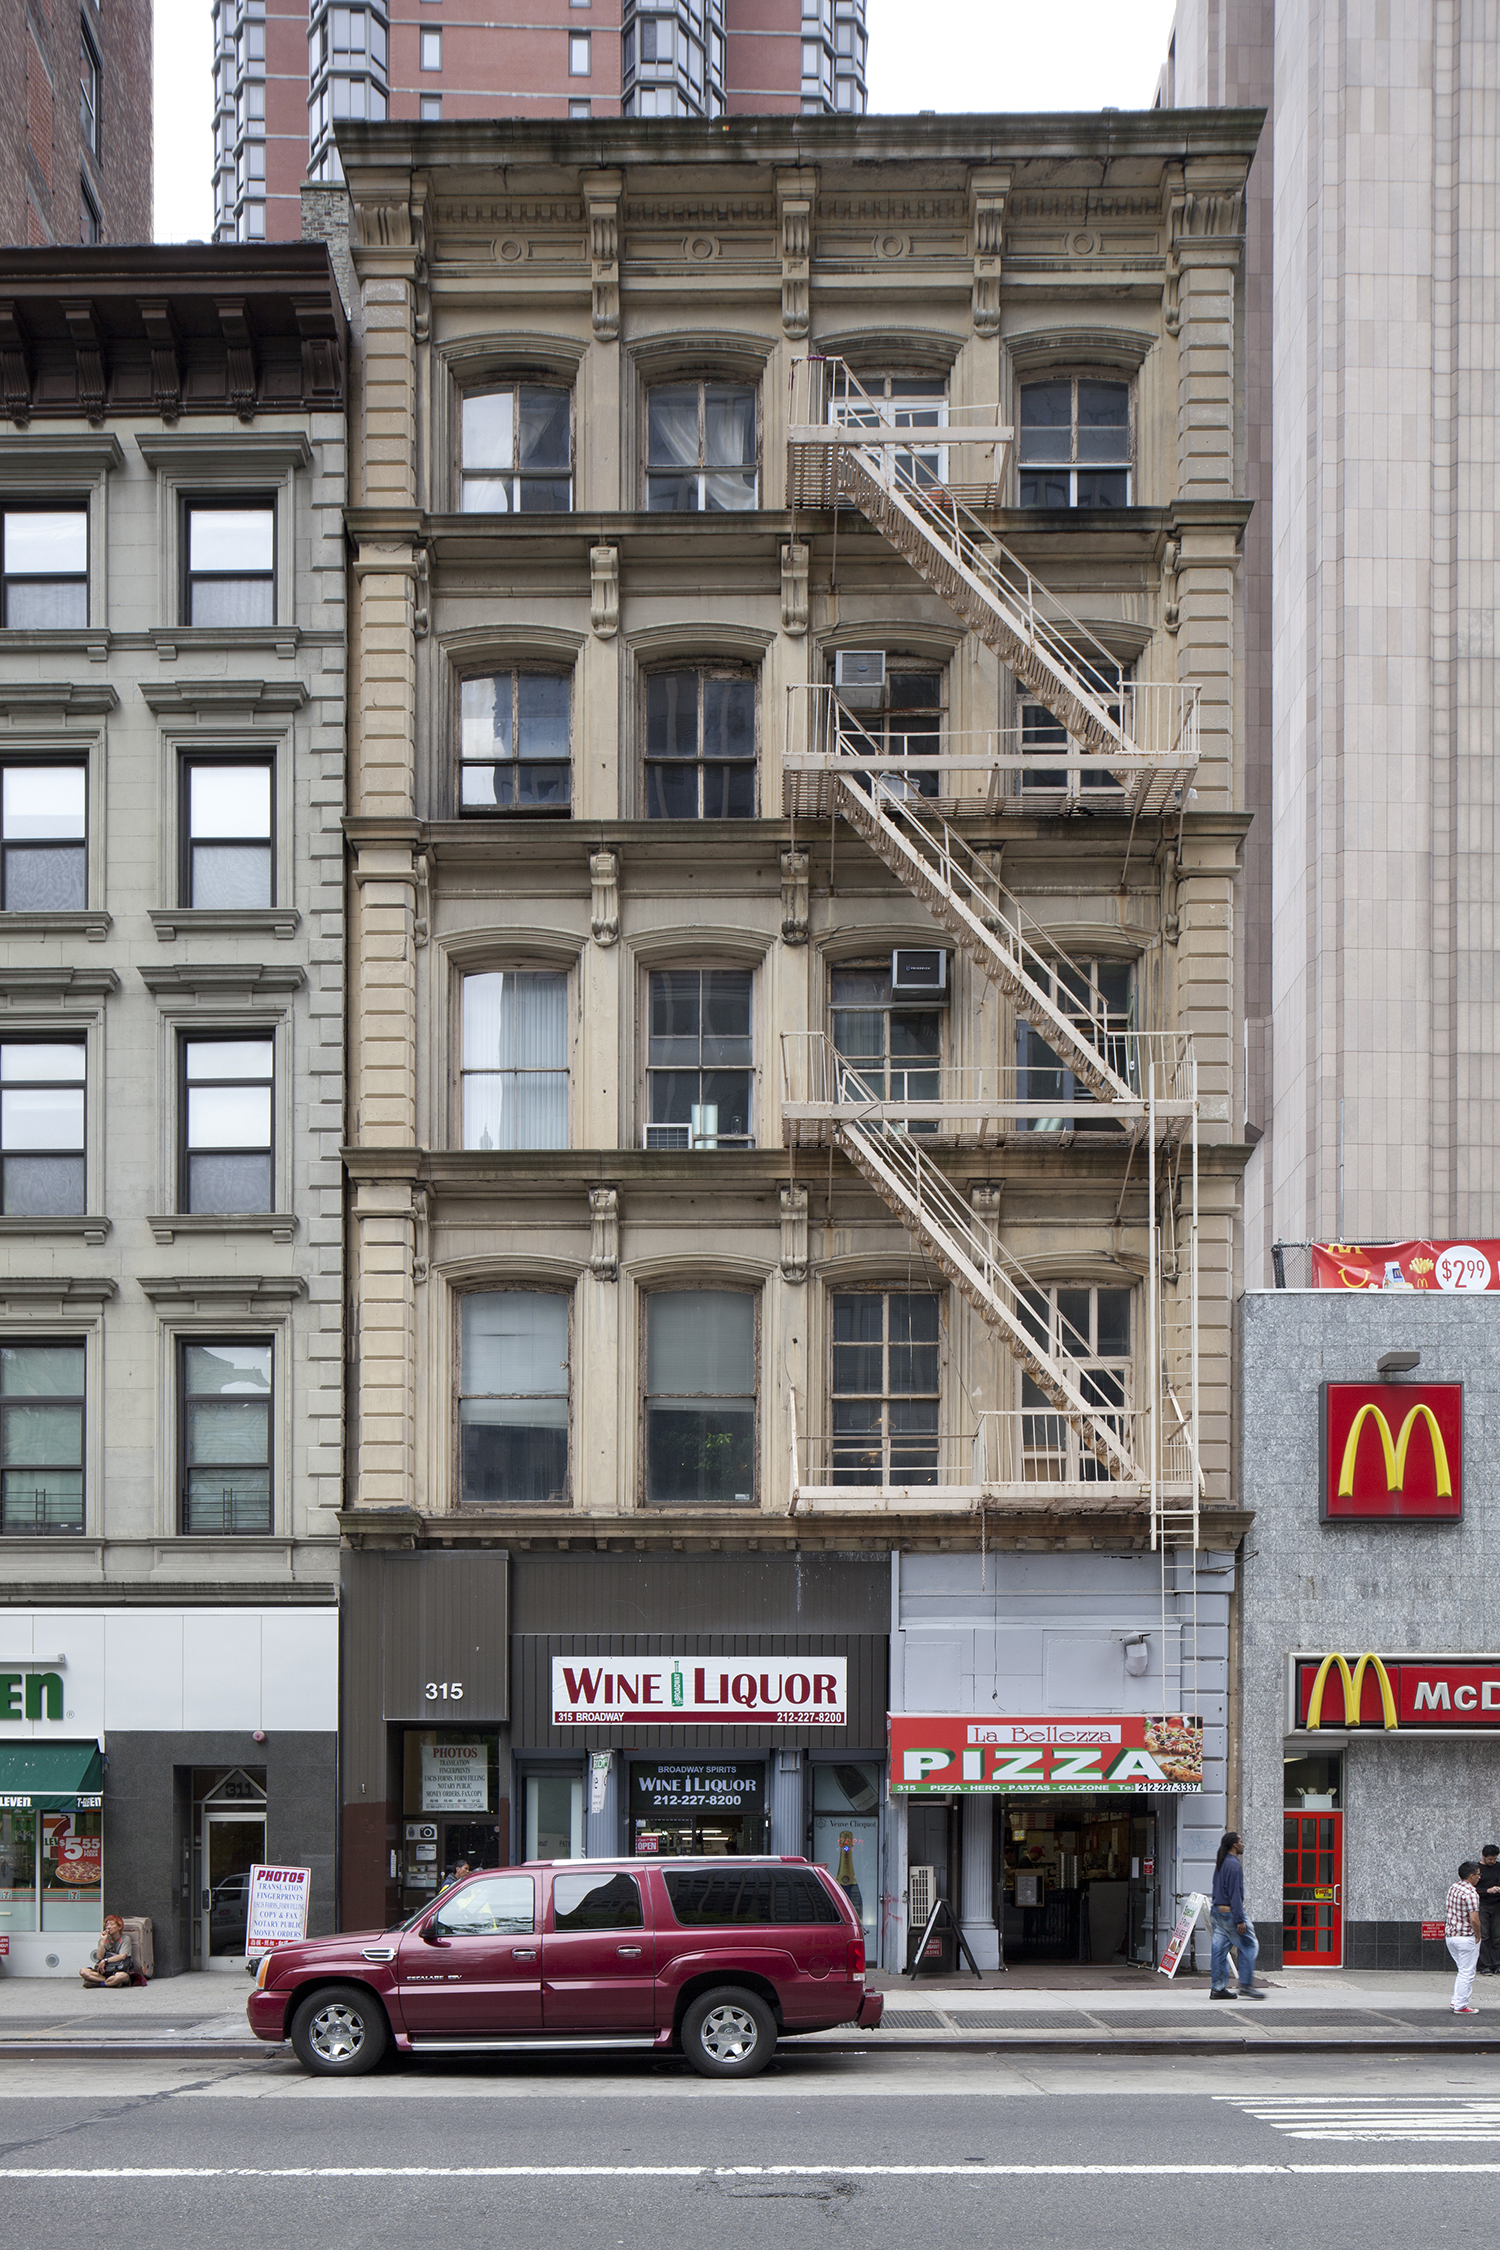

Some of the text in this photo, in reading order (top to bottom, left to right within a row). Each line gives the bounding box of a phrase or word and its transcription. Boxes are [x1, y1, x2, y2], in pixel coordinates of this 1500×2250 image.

[425, 1682, 464, 1700] 315
[563, 1668, 837, 1708] WINE LIQUOR
[558, 1712, 842, 1722] 315 BROADWAY 212-227-8200
[974, 1726, 1112, 1742] La Bellezza
[432, 1747, 478, 1758] PHOTOS
[903, 1748, 1168, 1780] PIZZA
[658, 1766, 736, 1774] BROADWAY SPIRITS
[225, 1782, 254, 1798] 311
[639, 1777, 756, 1793] WINE LIQUOR
[1138, 1784, 1199, 1792] 212-227-3337
[654, 1795, 742, 1805] 212-227-8200
[830, 1820, 876, 1829] Veuve Clicquot
[637, 1842, 657, 1850] OPEN
[257, 1870, 305, 1883] PHOTOS
[259, 1883, 302, 1891] TRANSLATION
[257, 1892, 303, 1901] FINGERPRINTS
